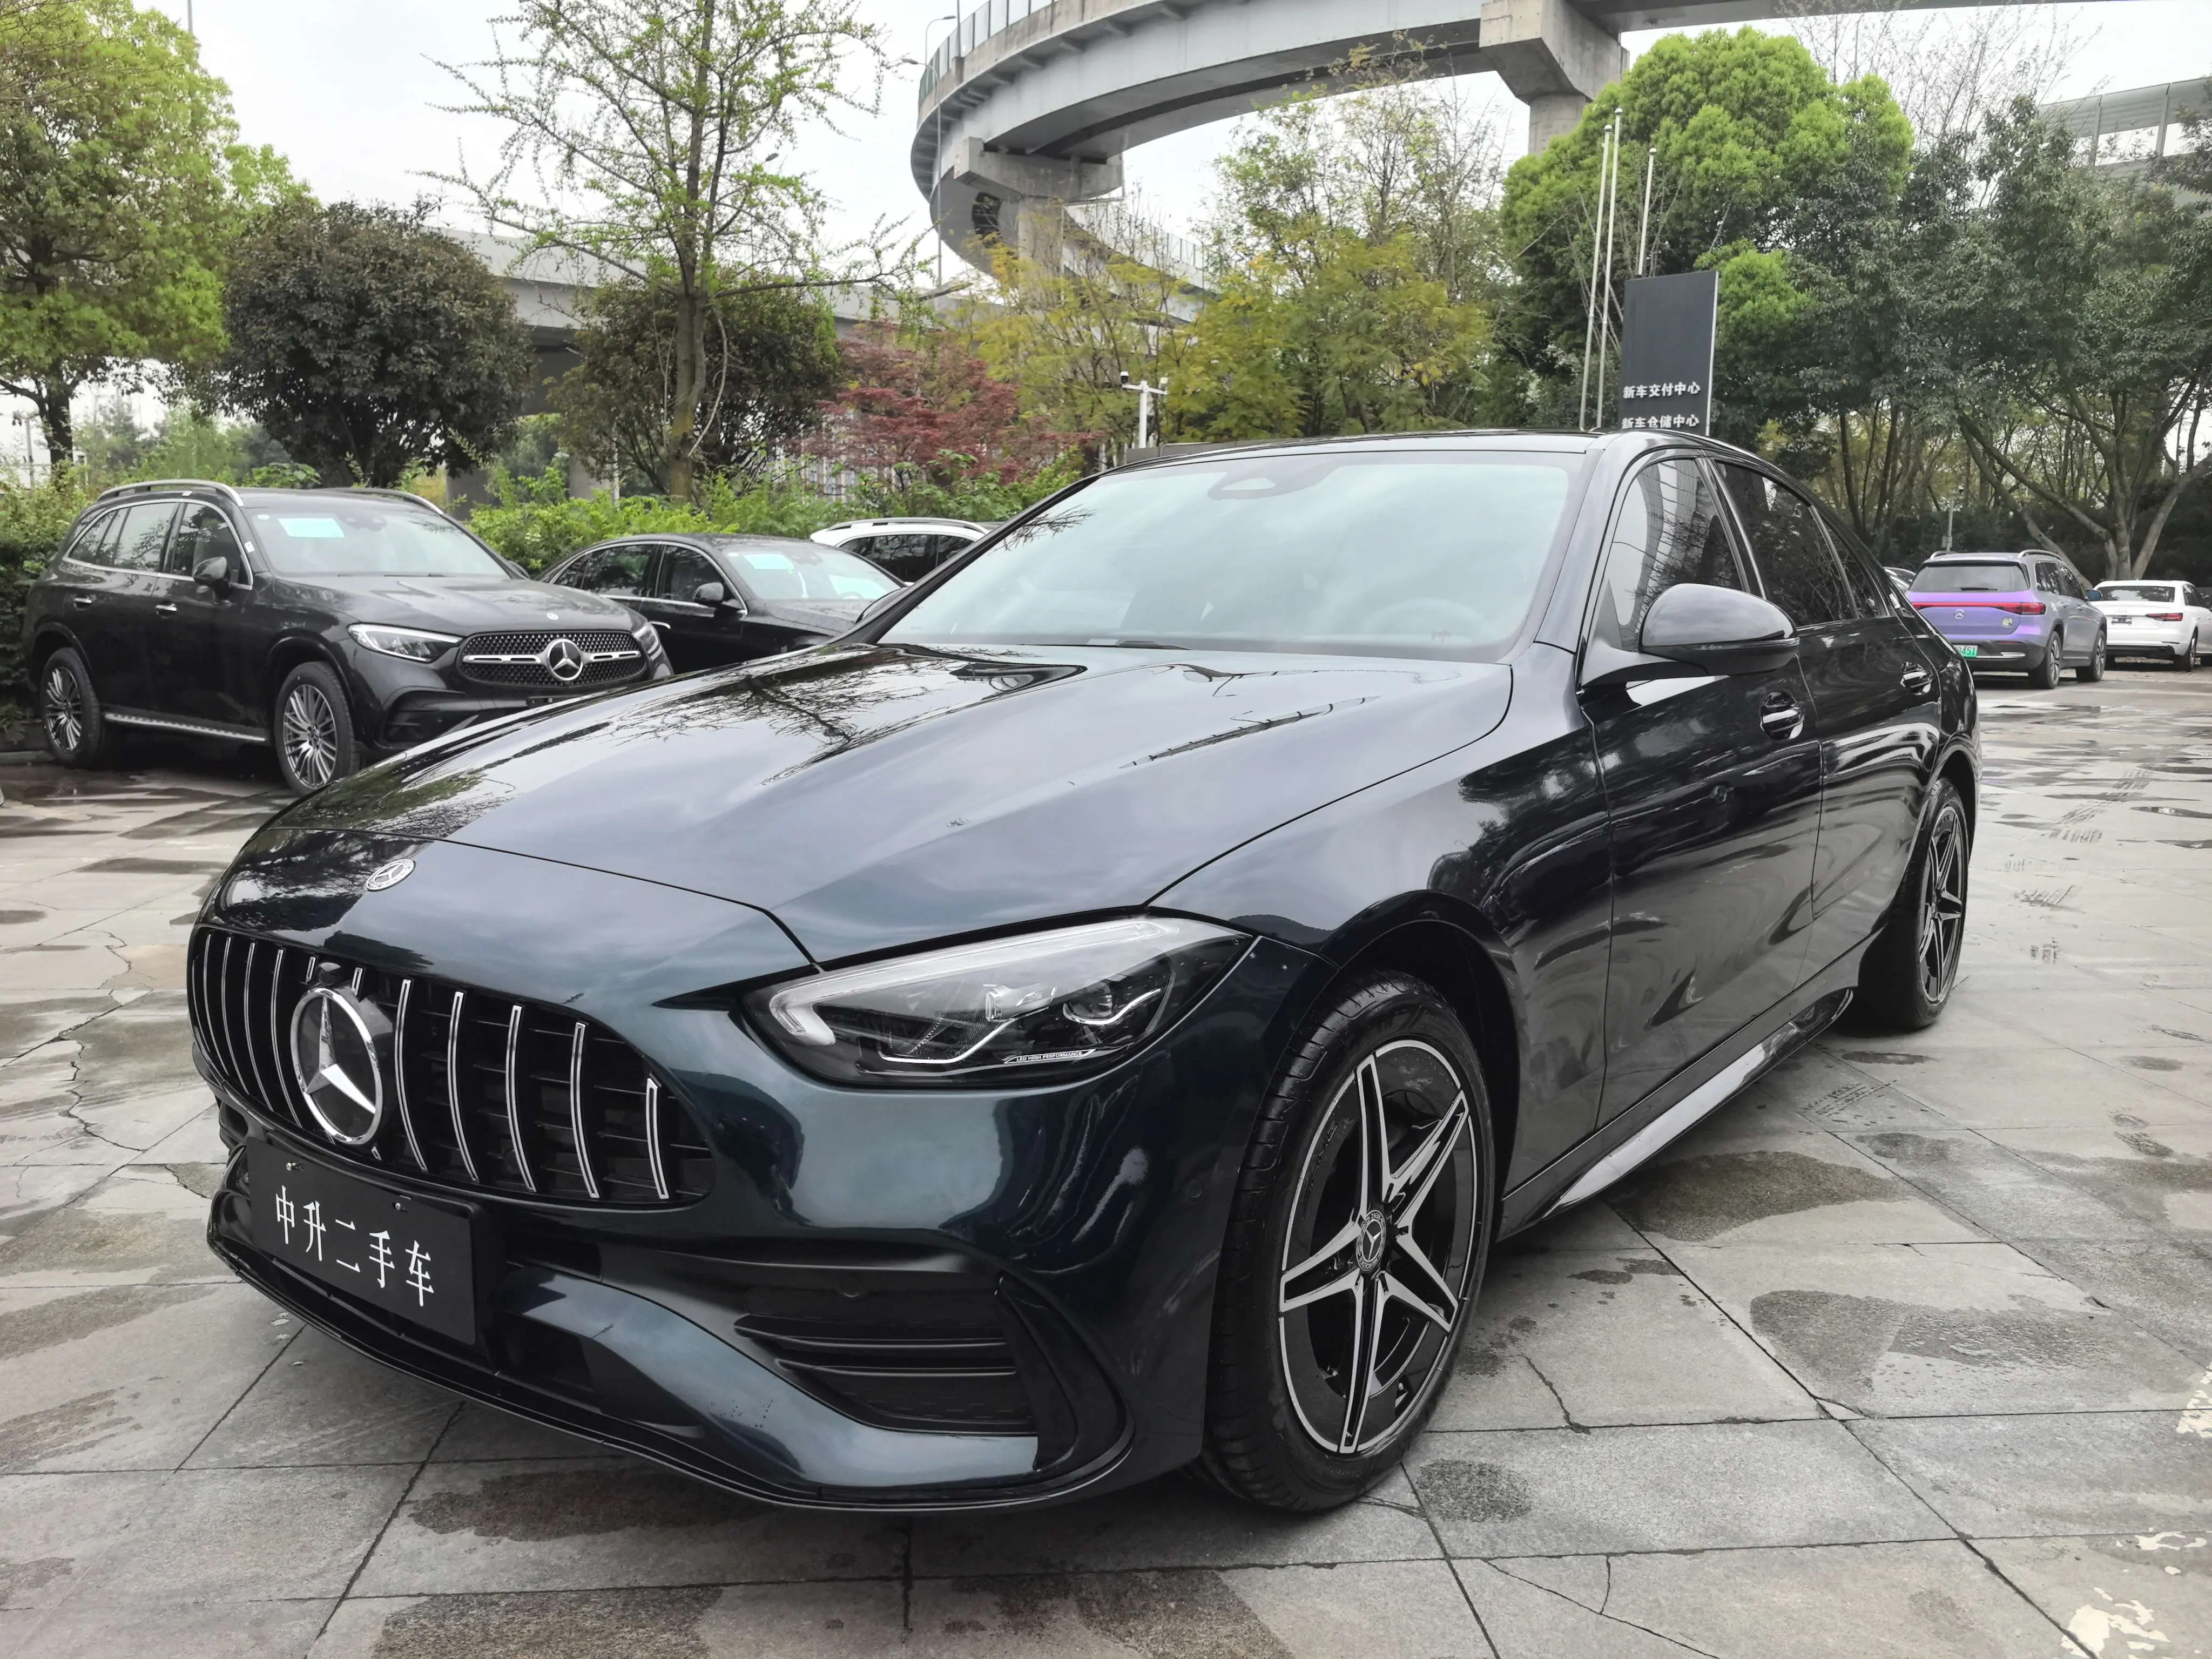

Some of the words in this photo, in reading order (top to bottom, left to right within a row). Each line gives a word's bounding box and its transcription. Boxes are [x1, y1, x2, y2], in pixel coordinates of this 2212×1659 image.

[1623, 381, 1701, 399] 新车交付中心
[1621, 414, 1700, 429] 新车仓储中心
[1042, 1051, 1082, 1060] PERFORMANCE
[275, 1185, 434, 1306] 中升二手车
